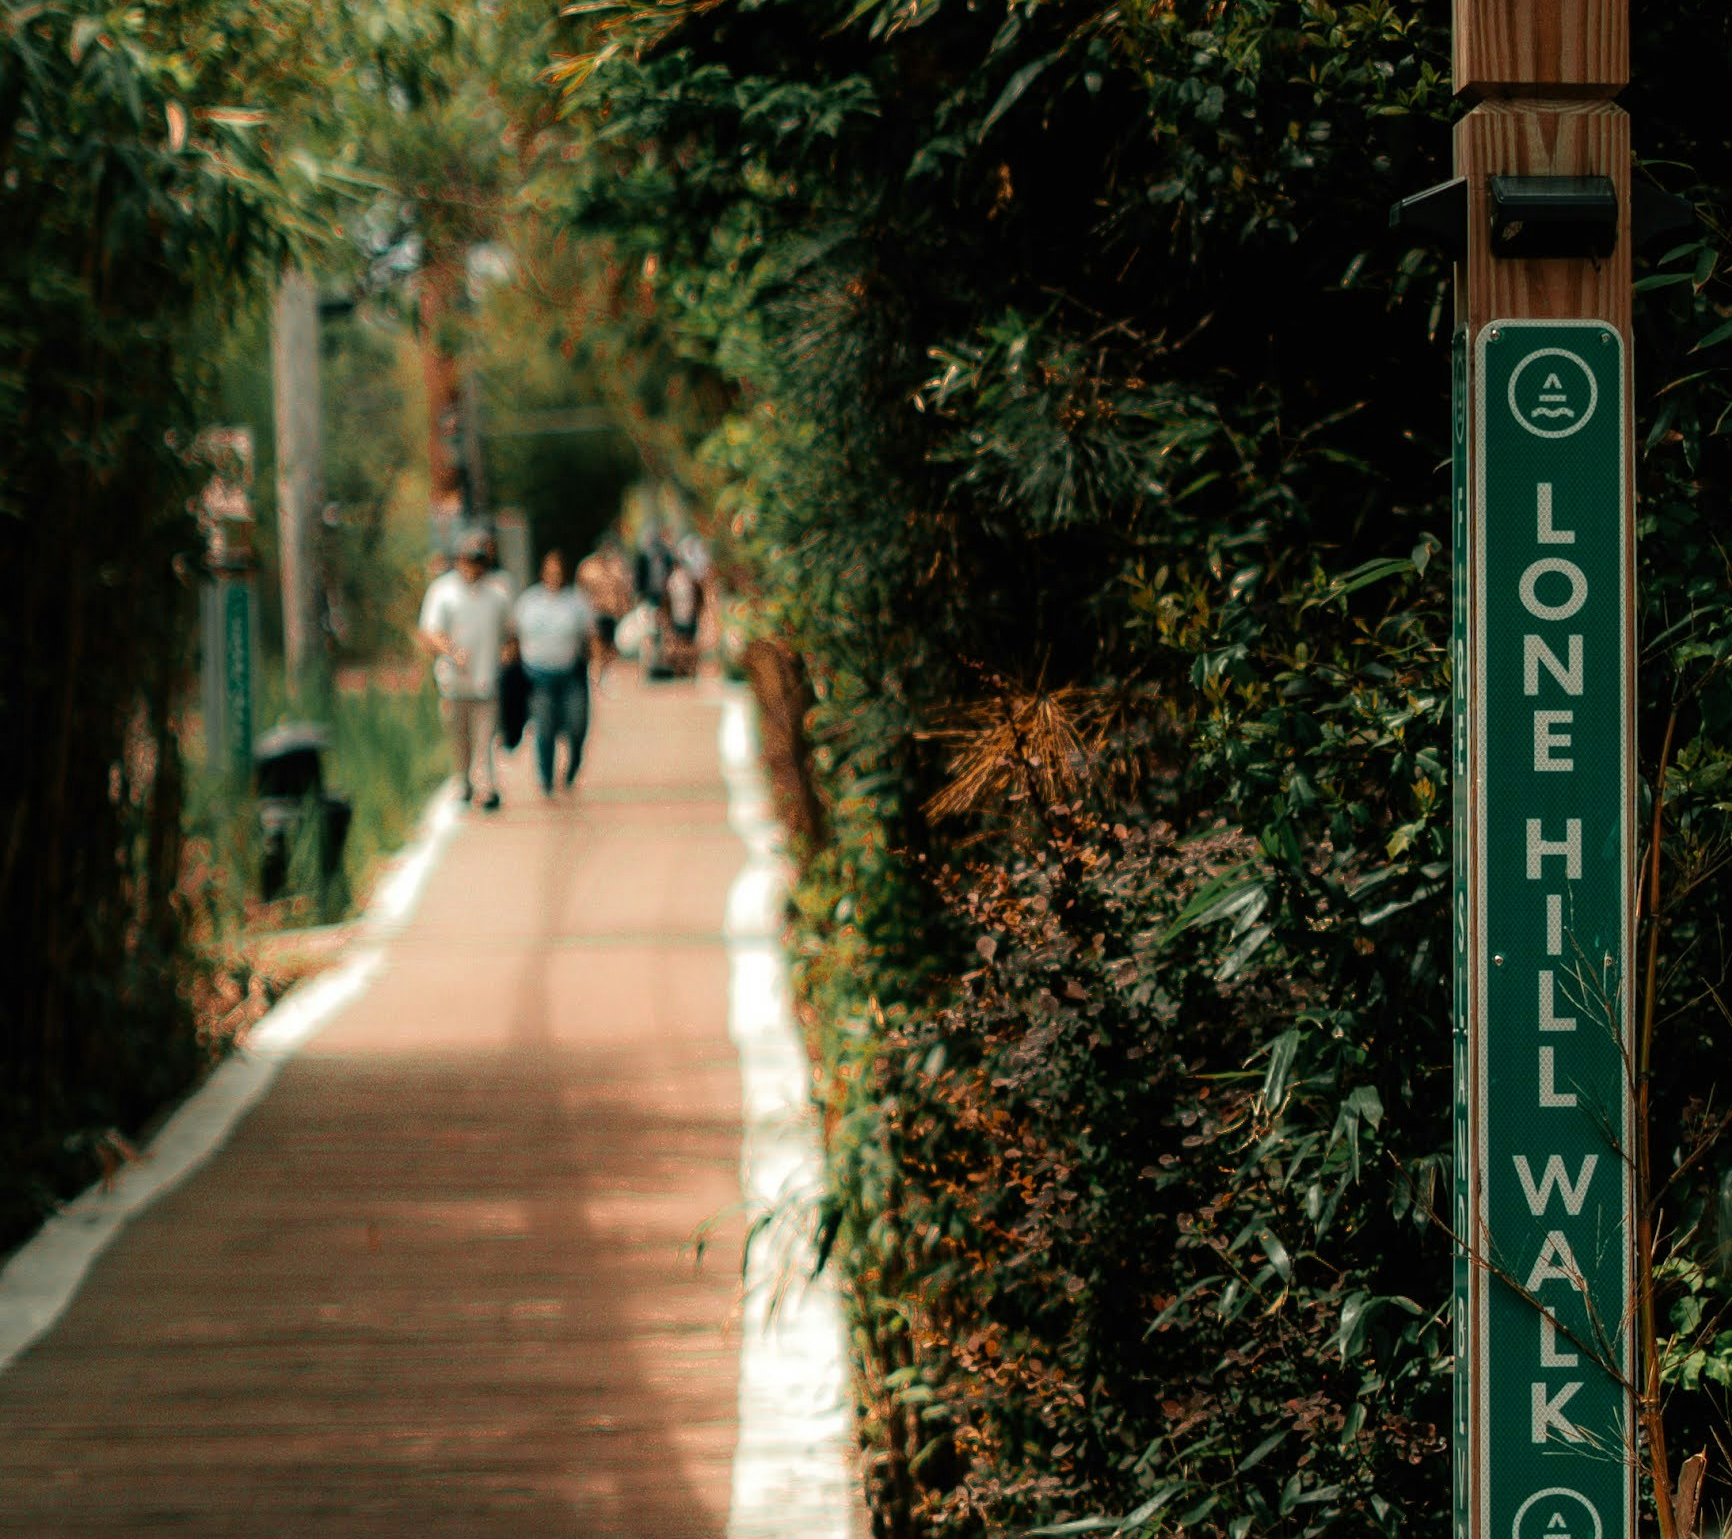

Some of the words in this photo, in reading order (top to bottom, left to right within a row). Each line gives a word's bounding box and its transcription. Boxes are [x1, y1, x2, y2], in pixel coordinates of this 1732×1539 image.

[1518, 482, 1588, 772] LONE
[1458, 816, 1466, 1254] ISLAND
[1526, 818, 1582, 1107] HILL
[1513, 1154, 1599, 1444] WALK
